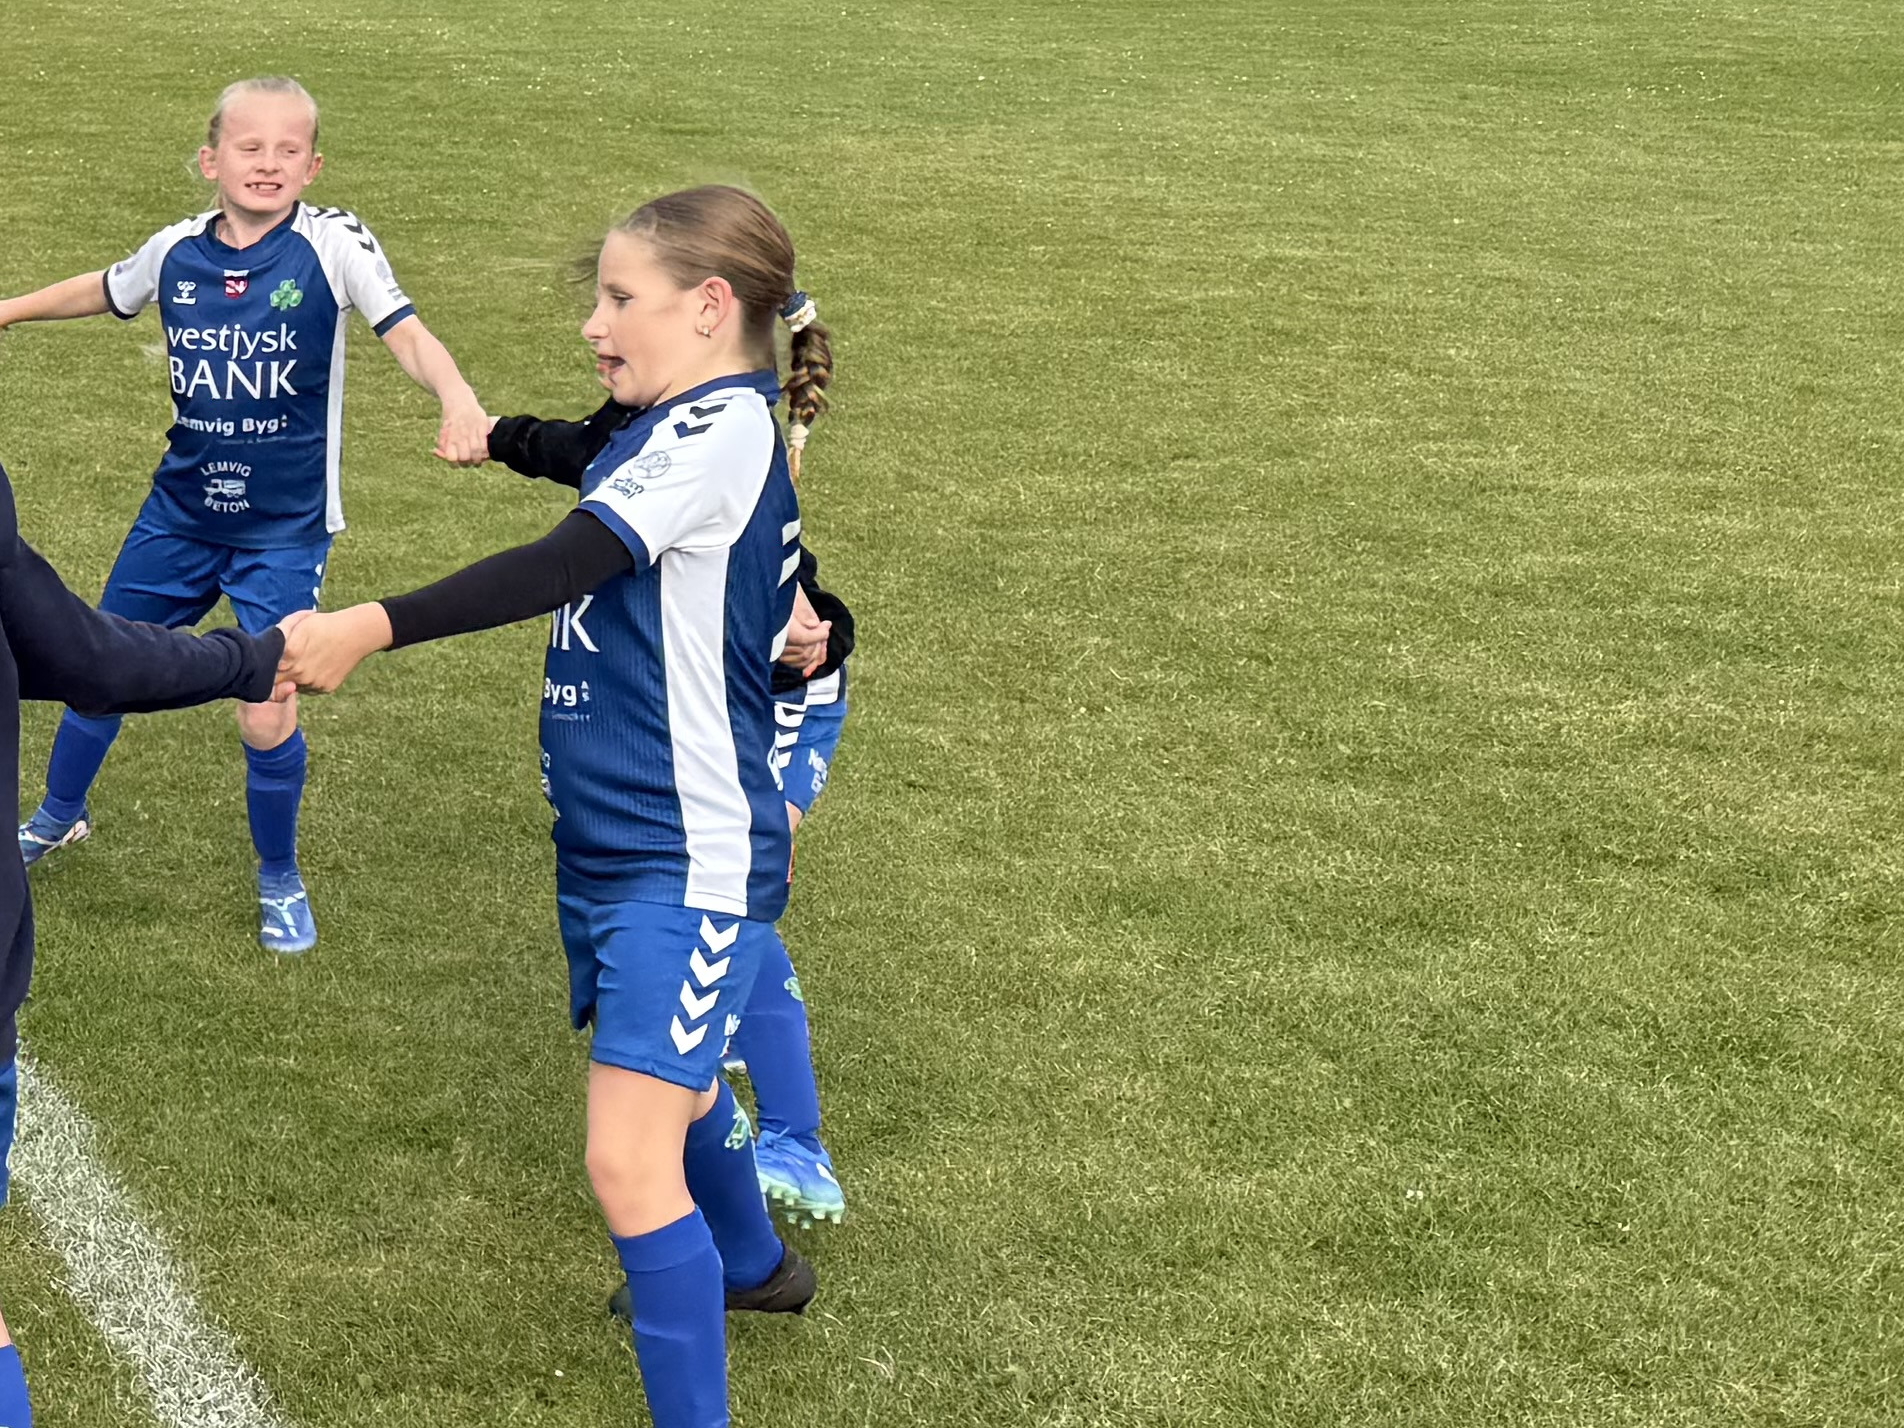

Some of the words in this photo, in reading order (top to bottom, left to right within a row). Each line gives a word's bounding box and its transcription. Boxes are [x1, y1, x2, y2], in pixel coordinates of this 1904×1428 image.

[168, 323, 298, 360] vestjysk
[169, 355, 298, 400] BANK
[242, 417, 280, 435] Byg
[200, 461, 252, 477] LEMVIG
